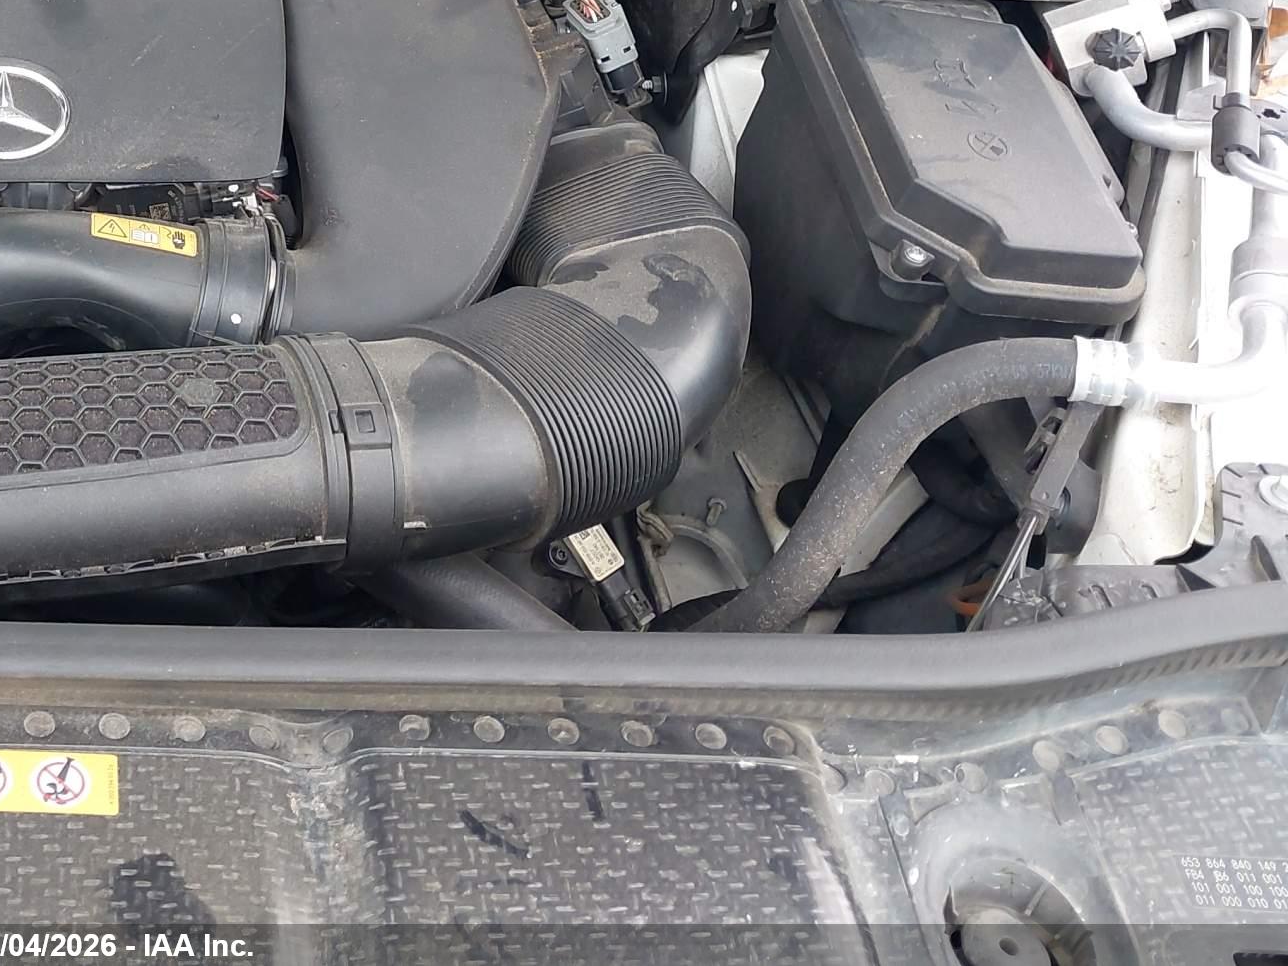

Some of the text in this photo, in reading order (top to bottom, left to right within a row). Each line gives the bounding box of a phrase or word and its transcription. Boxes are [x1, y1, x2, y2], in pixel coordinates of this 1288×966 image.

[1181, 857, 1201, 868] 653
[1205, 858, 1226, 869] 864
[1230, 859, 1252, 870] 840
[1257, 860, 1277, 871] 149
[1236, 872, 1257, 883] 011
[1262, 873, 1283, 884] 001
[1192, 881, 1210, 893] 101
[1216, 883, 1237, 894] 001
[1243, 884, 1263, 896] 100
[1195, 894, 1216, 906] 011
[1221, 896, 1242, 907] 000
[1248, 897, 1269, 908] 010
